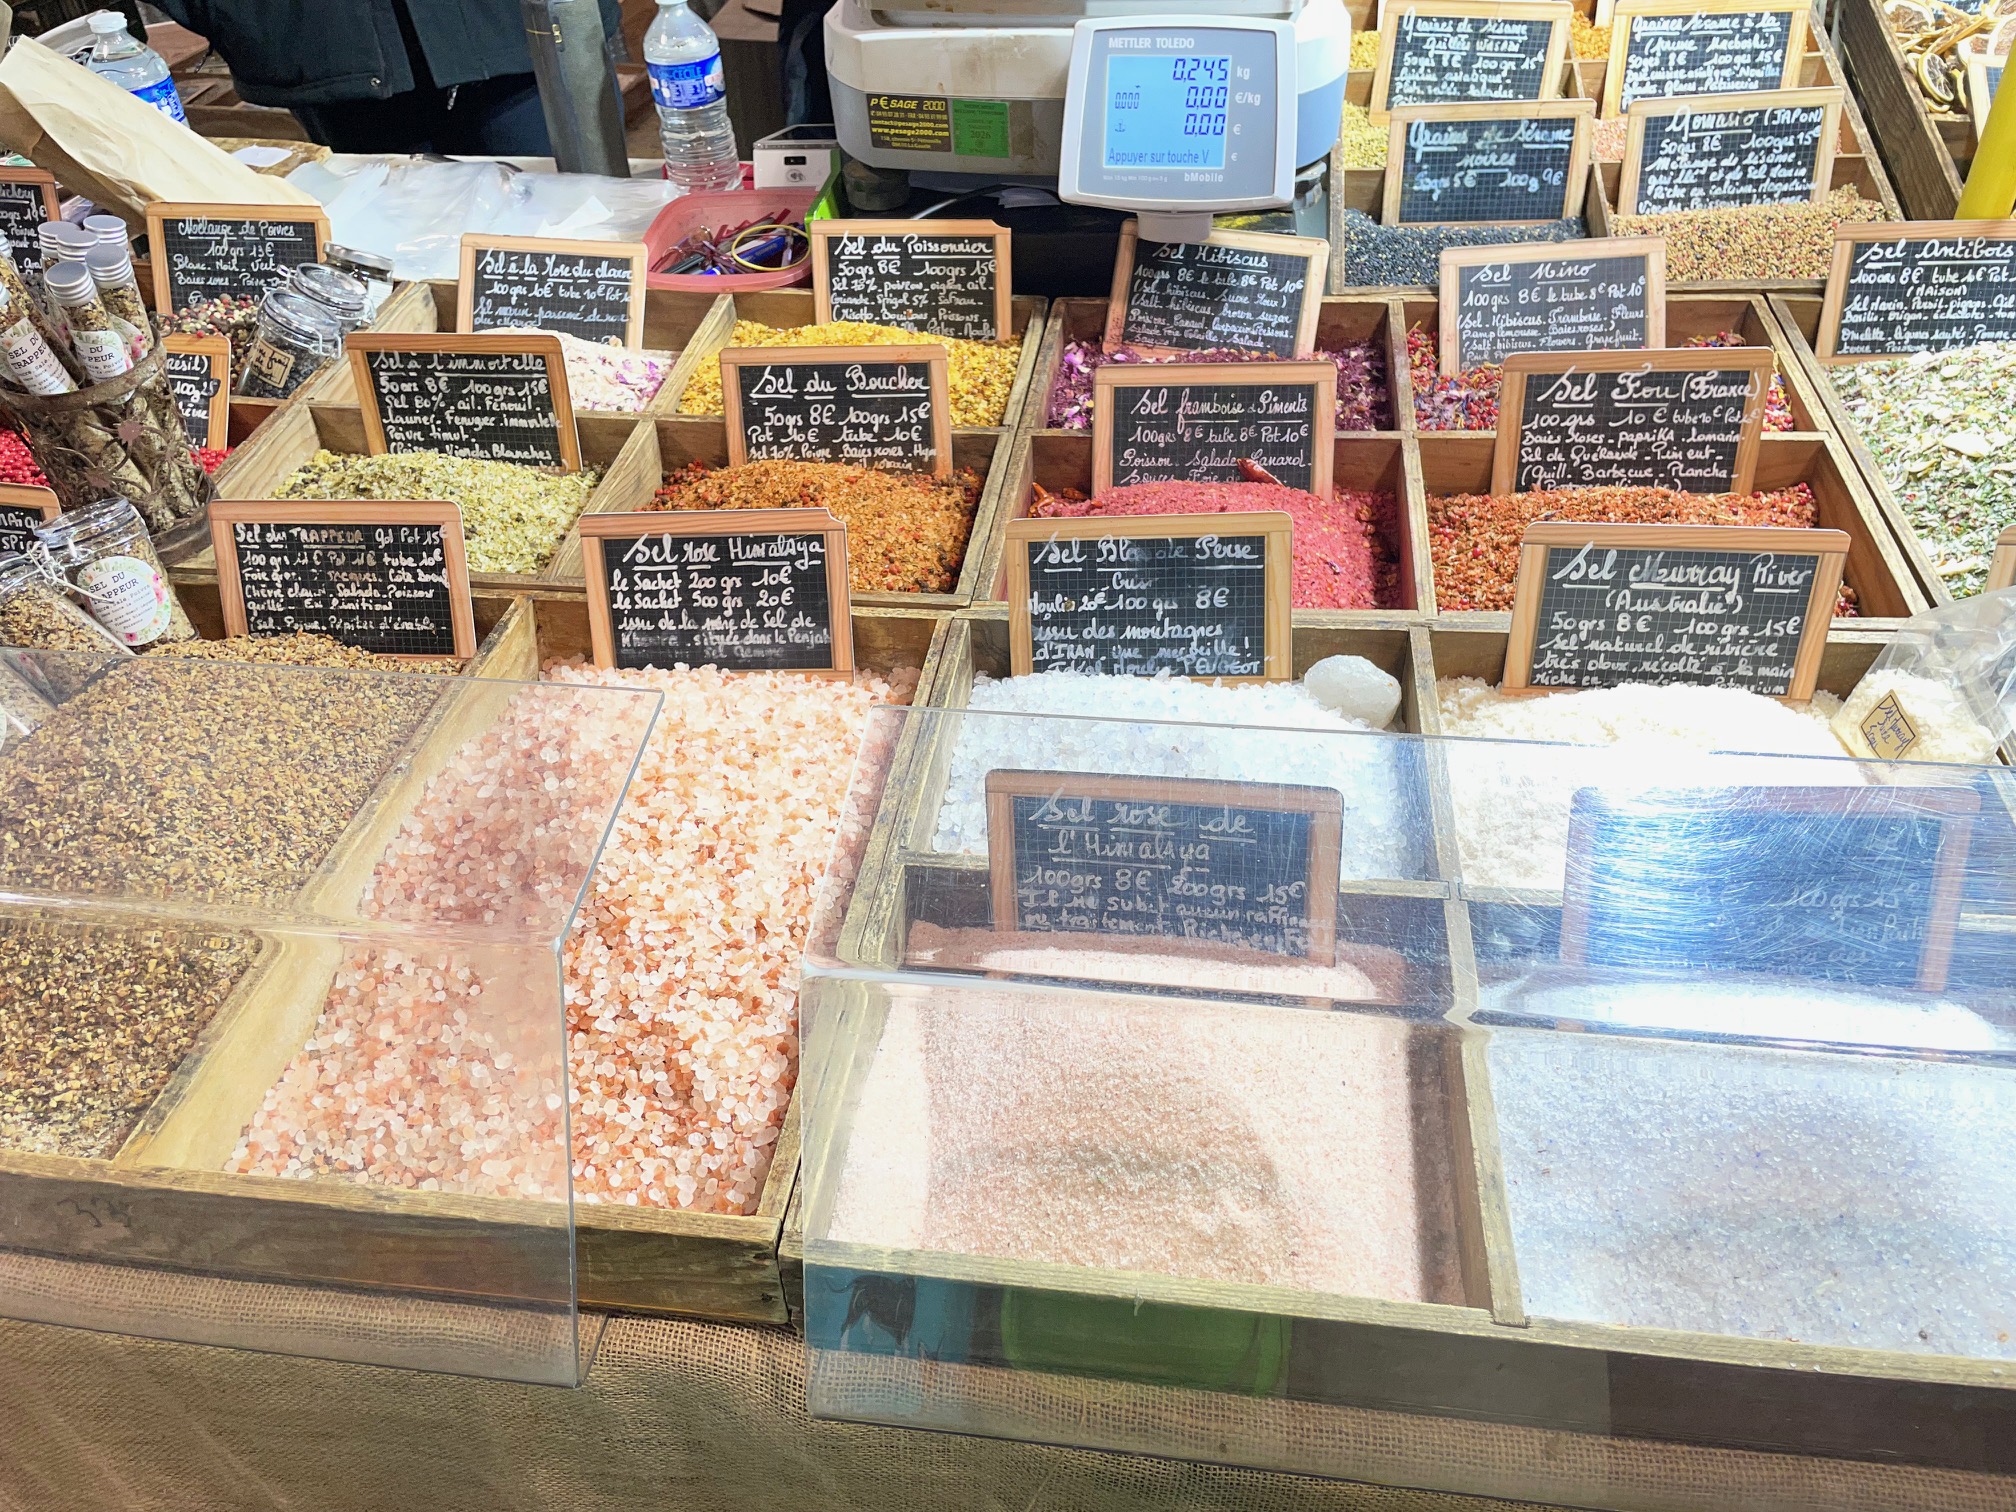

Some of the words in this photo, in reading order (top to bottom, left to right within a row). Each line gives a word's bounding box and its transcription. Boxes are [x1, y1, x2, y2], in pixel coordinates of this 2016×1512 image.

[1108, 37, 1152, 49] METTLER
[1156, 37, 1194, 49] TOLEDO
[1173, 58, 1229, 82] 0,245
[1236, 67, 1250, 83] kg
[922, 100, 946, 111] 2000
[1185, 86, 1228, 109] 0,00
[1234, 92, 1261, 107] €/kg
[871, 127, 949, 137] www.pesage2000.com
[1183, 113, 1226, 137] 0,00
[1233, 124, 1242, 135] €
[1108, 148, 1149, 164] Appuyer
[1151, 152, 1166, 163] sur
[1168, 149, 1200, 163] touche
[1203, 149, 1209, 163] V
[1184, 171, 1224, 182] bMobile
[834, 230, 869, 256] Sel
[870, 236, 902, 256] du
[902, 234, 994, 256] Poissonnier
[1856, 238, 1908, 263] Sel
[1914, 236, 2015, 262] Antibois
[477, 248, 506, 271] Sel
[520, 254, 539, 270] la
[573, 259, 593, 276] du
[1152, 243, 1184, 262] Sel
[1194, 246, 1269, 268] Hibiscus
[838, 261, 874, 284] 50grs
[877, 260, 901, 276] 8€
[913, 262, 966, 286] 100grs
[970, 261, 998, 276] 15€
[1470, 264, 1511, 283] Sel
[1529, 260, 1596, 283] Mino
[1462, 288, 1511, 312] 100grs
[1518, 287, 1546, 304] 8€
[1564, 286, 1590, 303] tube
[1589, 281, 1606, 300] 8€
[1607, 283, 1628, 299] Pot
[1627, 274, 1648, 298] 10€
[7, 346, 28, 360] SEL
[29, 332, 40, 346] DU
[89, 345, 104, 355] DU
[373, 348, 405, 370] Sel
[427, 349, 546, 371] l'immortelle
[424, 376, 451, 394] 8€
[462, 378, 514, 402] 100grs
[751, 365, 798, 395] Sel
[803, 370, 838, 394] du
[845, 364, 931, 396] Boucher
[1536, 365, 1598, 402] Sel
[1611, 362, 1681, 402] Fou
[1680, 370, 1762, 403] (France)
[763, 405, 805, 436] 50grs
[809, 405, 837, 426] 8€
[837, 406, 892, 434] 100grs
[893, 401, 932, 424] 15€
[1130, 387, 1169, 414] Sel
[1174, 387, 1245, 435] framboise
[1257, 389, 1308, 415] Piments
[746, 429, 774, 444] Pot
[779, 428, 820, 444] 10€
[831, 427, 879, 444] tube
[882, 427, 922, 444] 10€
[1128, 428, 1178, 451] 100grs
[1183, 427, 1205, 443] 8€
[1205, 426, 1238, 443] tube
[1239, 425, 1260, 442] 8€
[1260, 427, 1284, 443] Pot
[1283, 424, 1309, 443] 10€
[492, 443, 552, 461] Blanches
[1521, 445, 1543, 463] Sel
[1546, 448, 1567, 463] de
[234, 523, 262, 544] Sel
[266, 525, 288, 544] du
[289, 527, 364, 543] TRAPPEUR
[400, 528, 421, 545] Pot
[622, 533, 679, 564] Sel
[729, 534, 826, 571] Himalaya
[1032, 531, 1087, 565] Sel
[1194, 533, 1260, 561] Perse
[1553, 540, 1618, 581] Sel
[1750, 553, 1812, 586] River
[89, 580, 108, 594] SEL
[111, 572, 126, 585] DU
[610, 570, 636, 592] le
[634, 570, 682, 591] Sachet
[688, 573, 718, 590] 200
[751, 566, 793, 587] 10€
[611, 591, 638, 611] le
[637, 590, 683, 610] Sachet
[692, 590, 719, 607] 500
[756, 587, 795, 608] 20€
[1605, 591, 1744, 615] (Australie)
[618, 611, 656, 631] issu
[657, 612, 682, 631] de
[682, 607, 707, 631] la
[741, 608, 763, 630] de
[762, 607, 785, 628] Sel
[790, 611, 816, 629] de
[1550, 611, 1606, 640] 50grs
[1673, 616, 1749, 644] 100grs
[1753, 616, 1800, 640] 15€
[1540, 634, 1579, 652] Sel
[1583, 634, 1664, 654] naturel
[1667, 636, 1699, 656] de
[1699, 640, 1778, 662] rivière
[1028, 785, 1096, 823] Sel
[1107, 800, 1190, 828] rose
[1199, 804, 1254, 833] de
[1022, 865, 1103, 897] 100grs
[1115, 866, 1152, 891] 8€
[1170, 865, 1247, 904] 200grs
[1255, 878, 1306, 904] 15€
